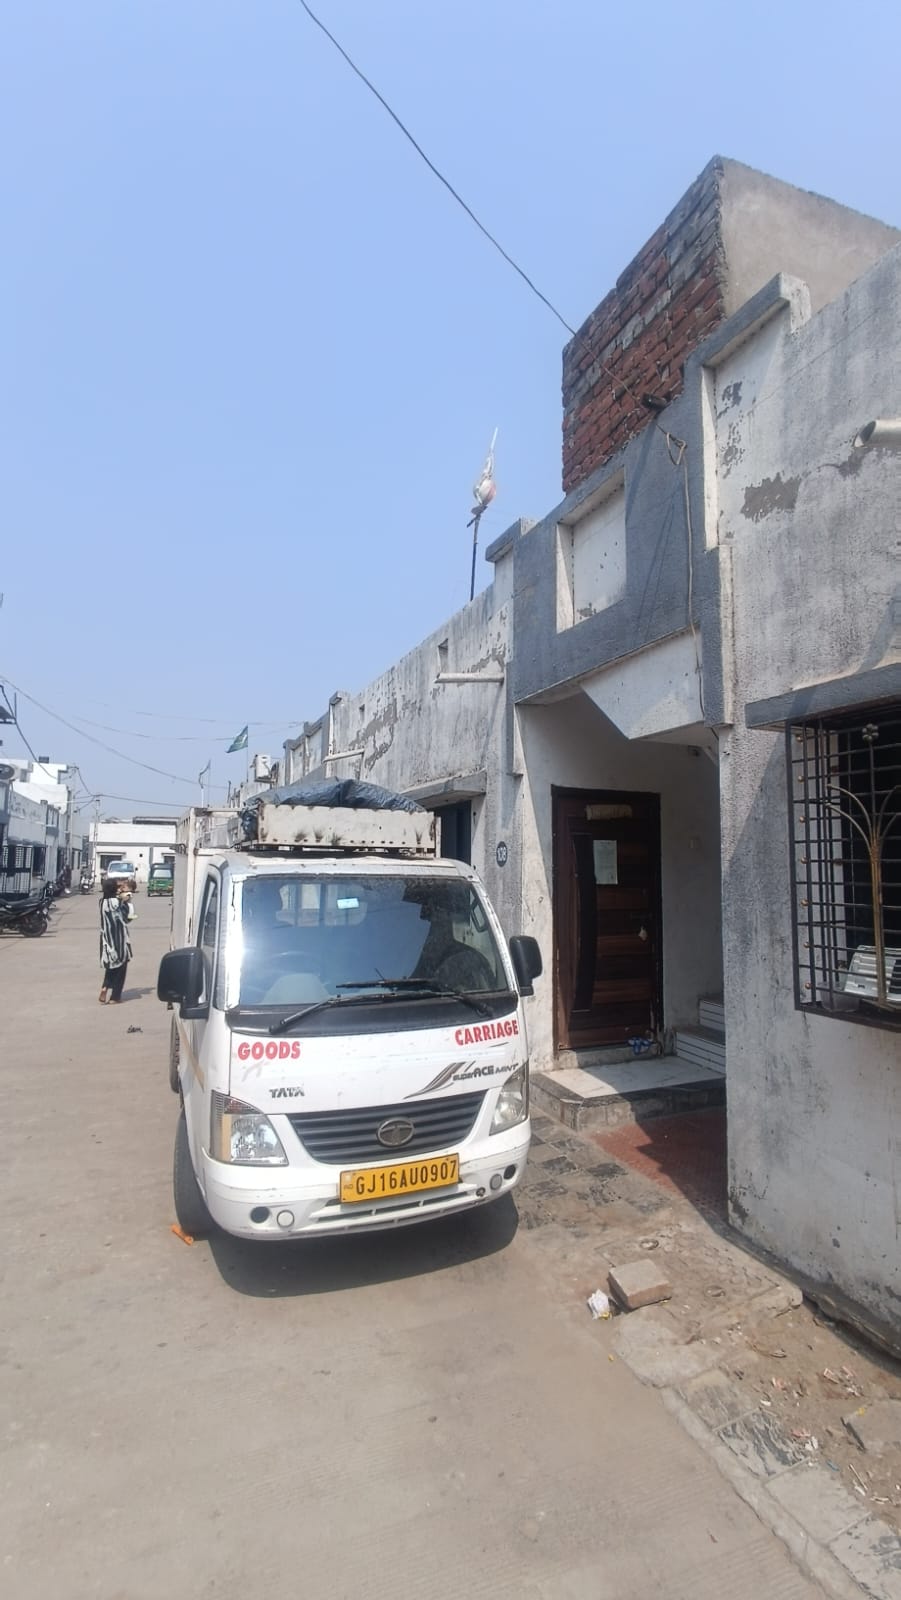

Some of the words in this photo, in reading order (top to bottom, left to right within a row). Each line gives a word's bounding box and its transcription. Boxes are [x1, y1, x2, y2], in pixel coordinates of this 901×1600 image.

[238, 1041, 301, 1060] GOODS
[455, 1020, 519, 1045] CARRIAGE
[269, 1087, 305, 1098] TATA
[356, 1161, 457, 1194] GJ16AU0907
